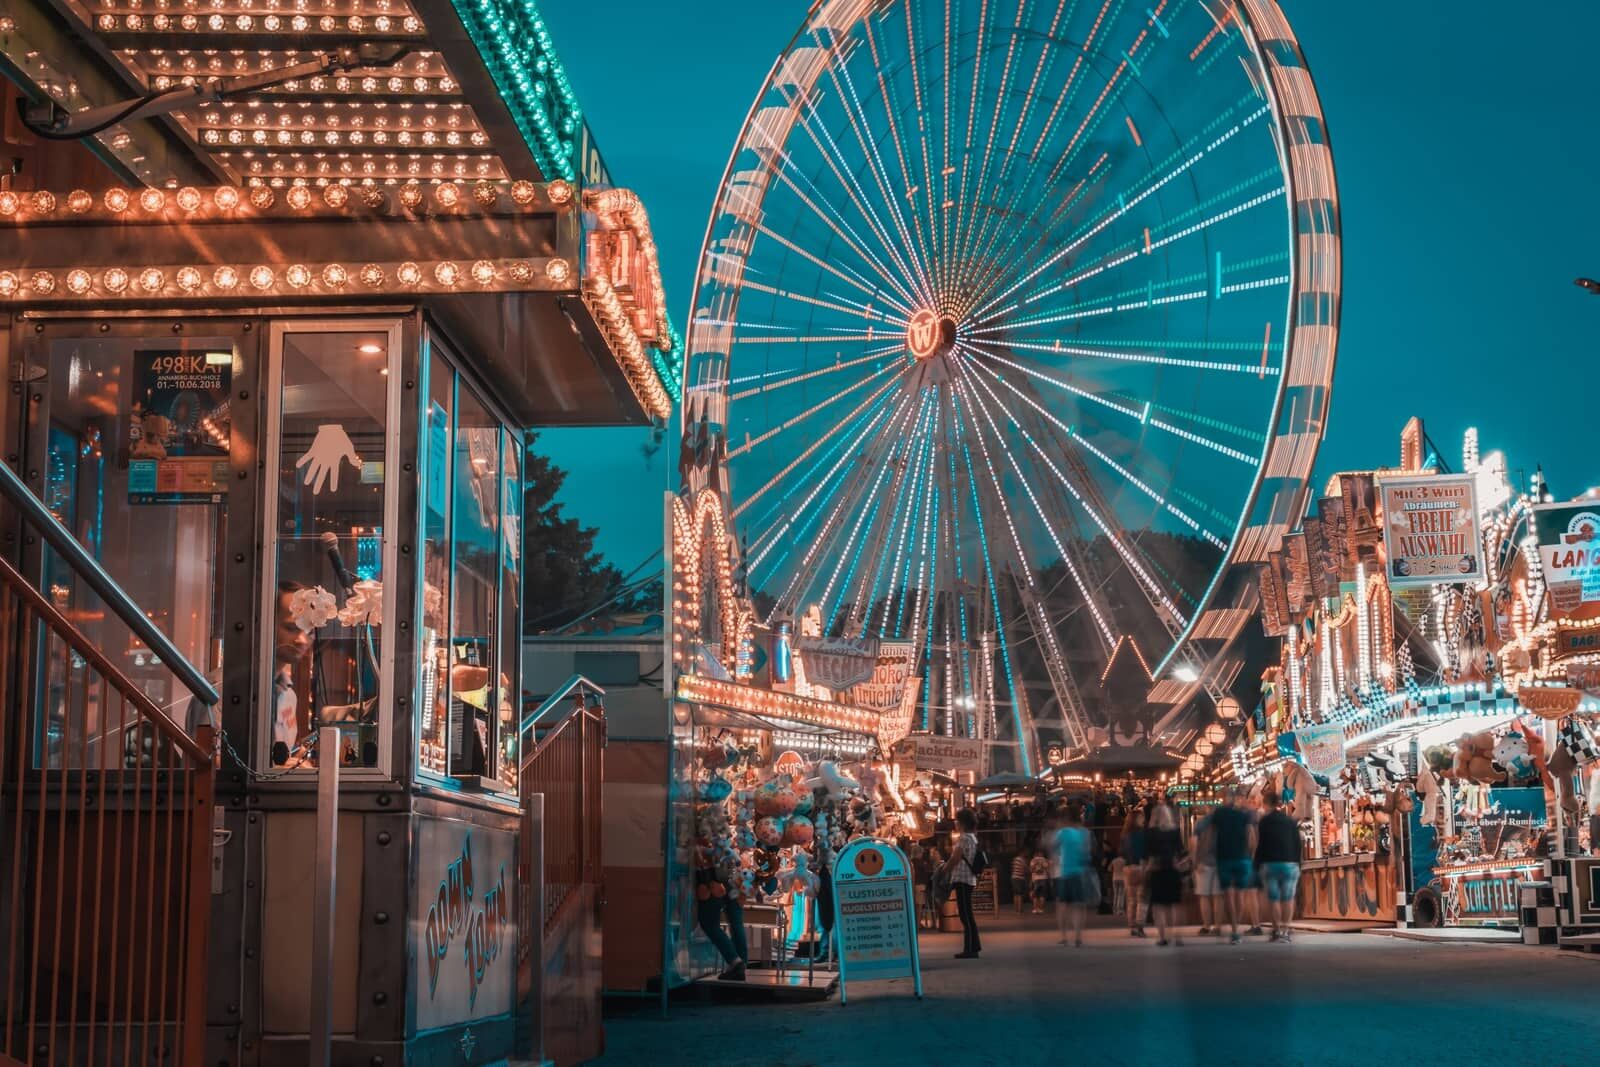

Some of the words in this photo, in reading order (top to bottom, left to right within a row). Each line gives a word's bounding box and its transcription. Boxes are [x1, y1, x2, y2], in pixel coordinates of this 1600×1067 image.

[152, 356, 184, 374] 498
[1393, 490, 1413, 499] Mit
[1417, 486, 1428, 499] 3
[1432, 487, 1465, 498] Wurf
[1403, 500, 1460, 512] Abräumen:
[1408, 510, 1455, 533] FREIE
[1400, 533, 1467, 557] AUSWAHL
[918, 745, 977, 760] ackfisch
[778, 762, 801, 777] STOP
[848, 888, 895, 899] LUSTIGES
[1463, 879, 1520, 913] SCHEFFLE
